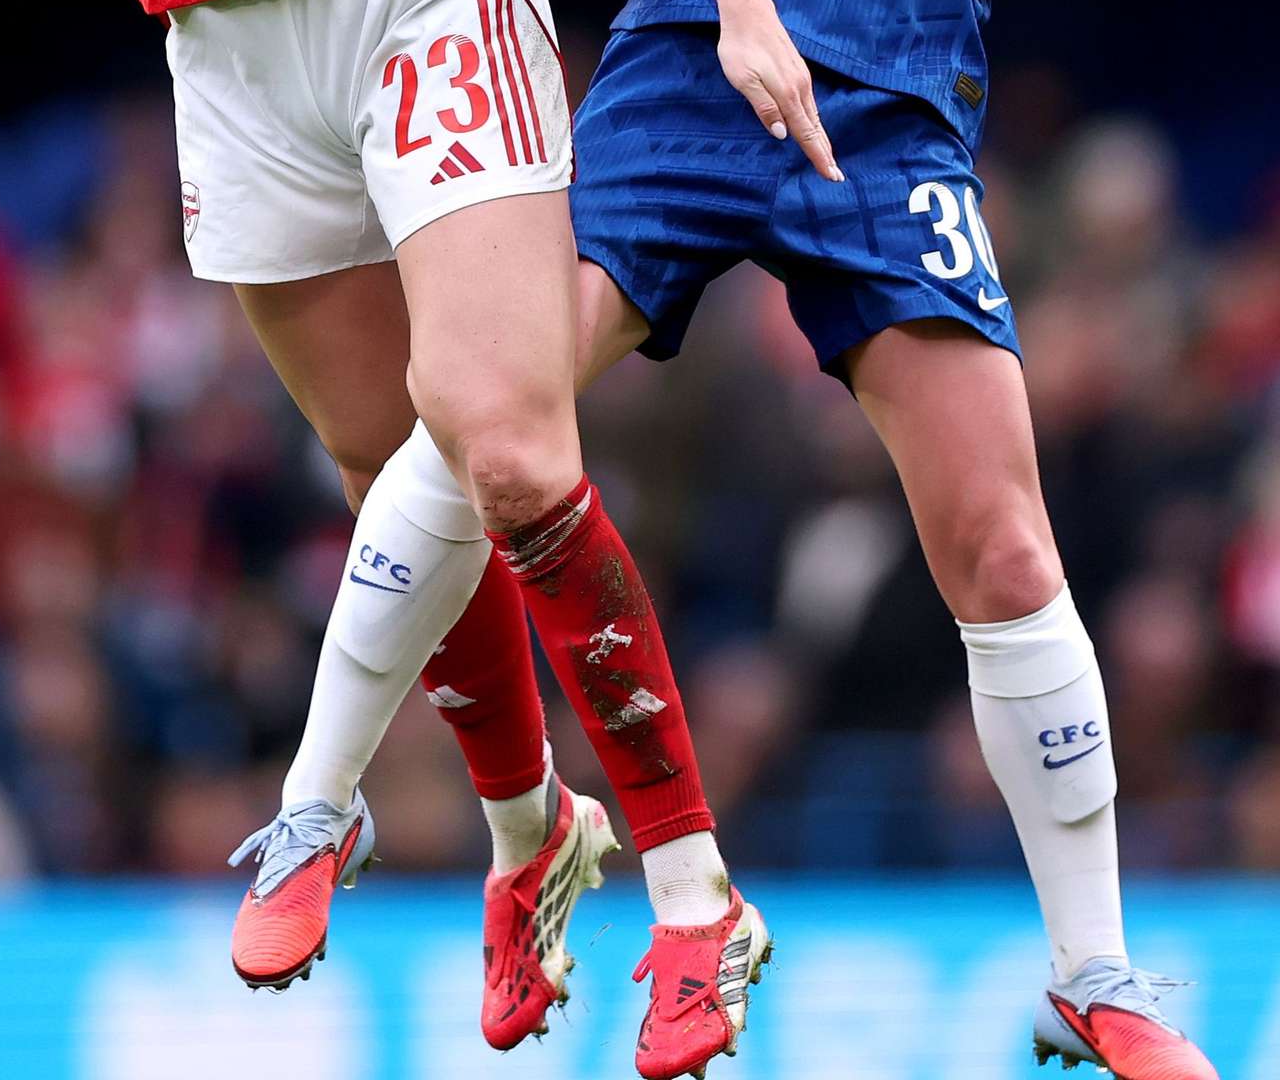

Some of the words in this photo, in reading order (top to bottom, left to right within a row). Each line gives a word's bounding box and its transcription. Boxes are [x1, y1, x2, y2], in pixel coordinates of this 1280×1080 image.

[381, 33, 491, 159] 23
[908, 181, 1000, 282] 30
[360, 544, 412, 585] CFC
[1038, 720, 1101, 748] CFC
